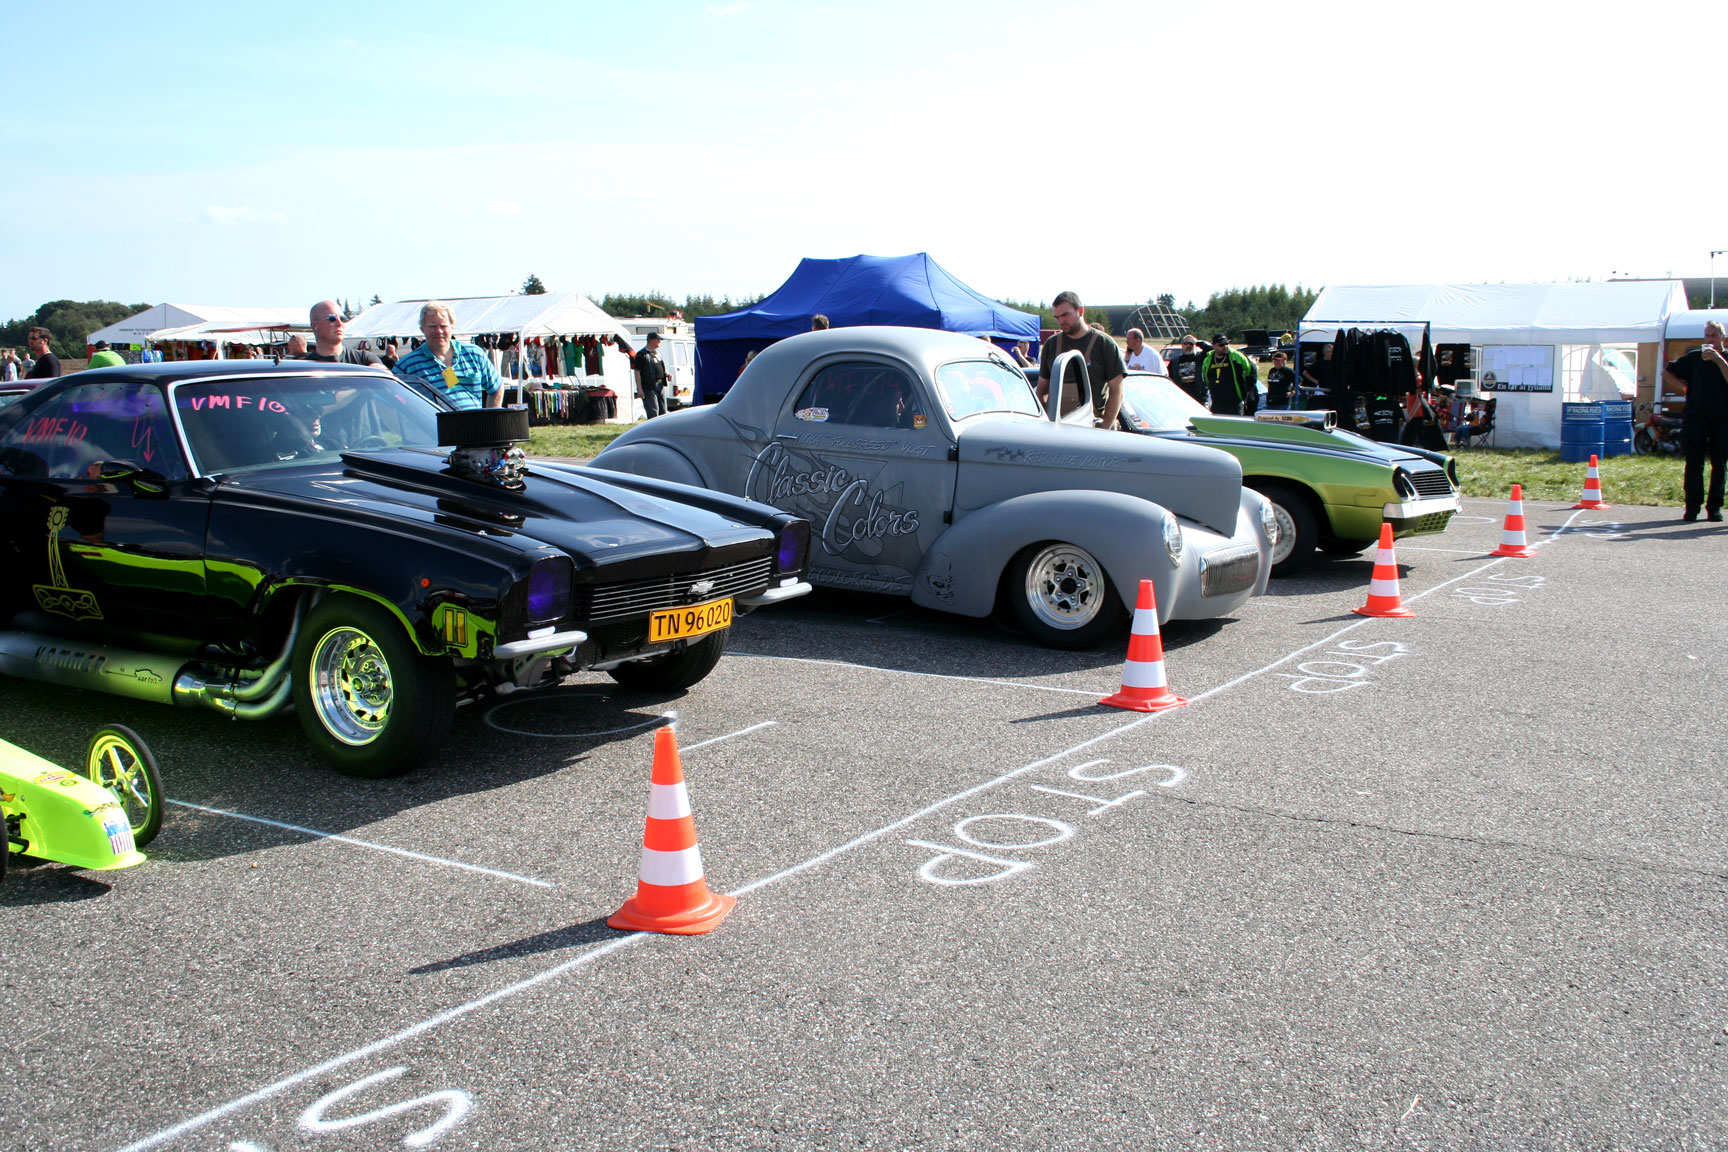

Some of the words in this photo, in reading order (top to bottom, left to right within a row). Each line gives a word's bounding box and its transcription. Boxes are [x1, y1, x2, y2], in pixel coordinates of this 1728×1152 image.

[744, 441, 849, 505] Classic
[822, 479, 920, 556] Colors
[654, 612, 681, 636] TN
